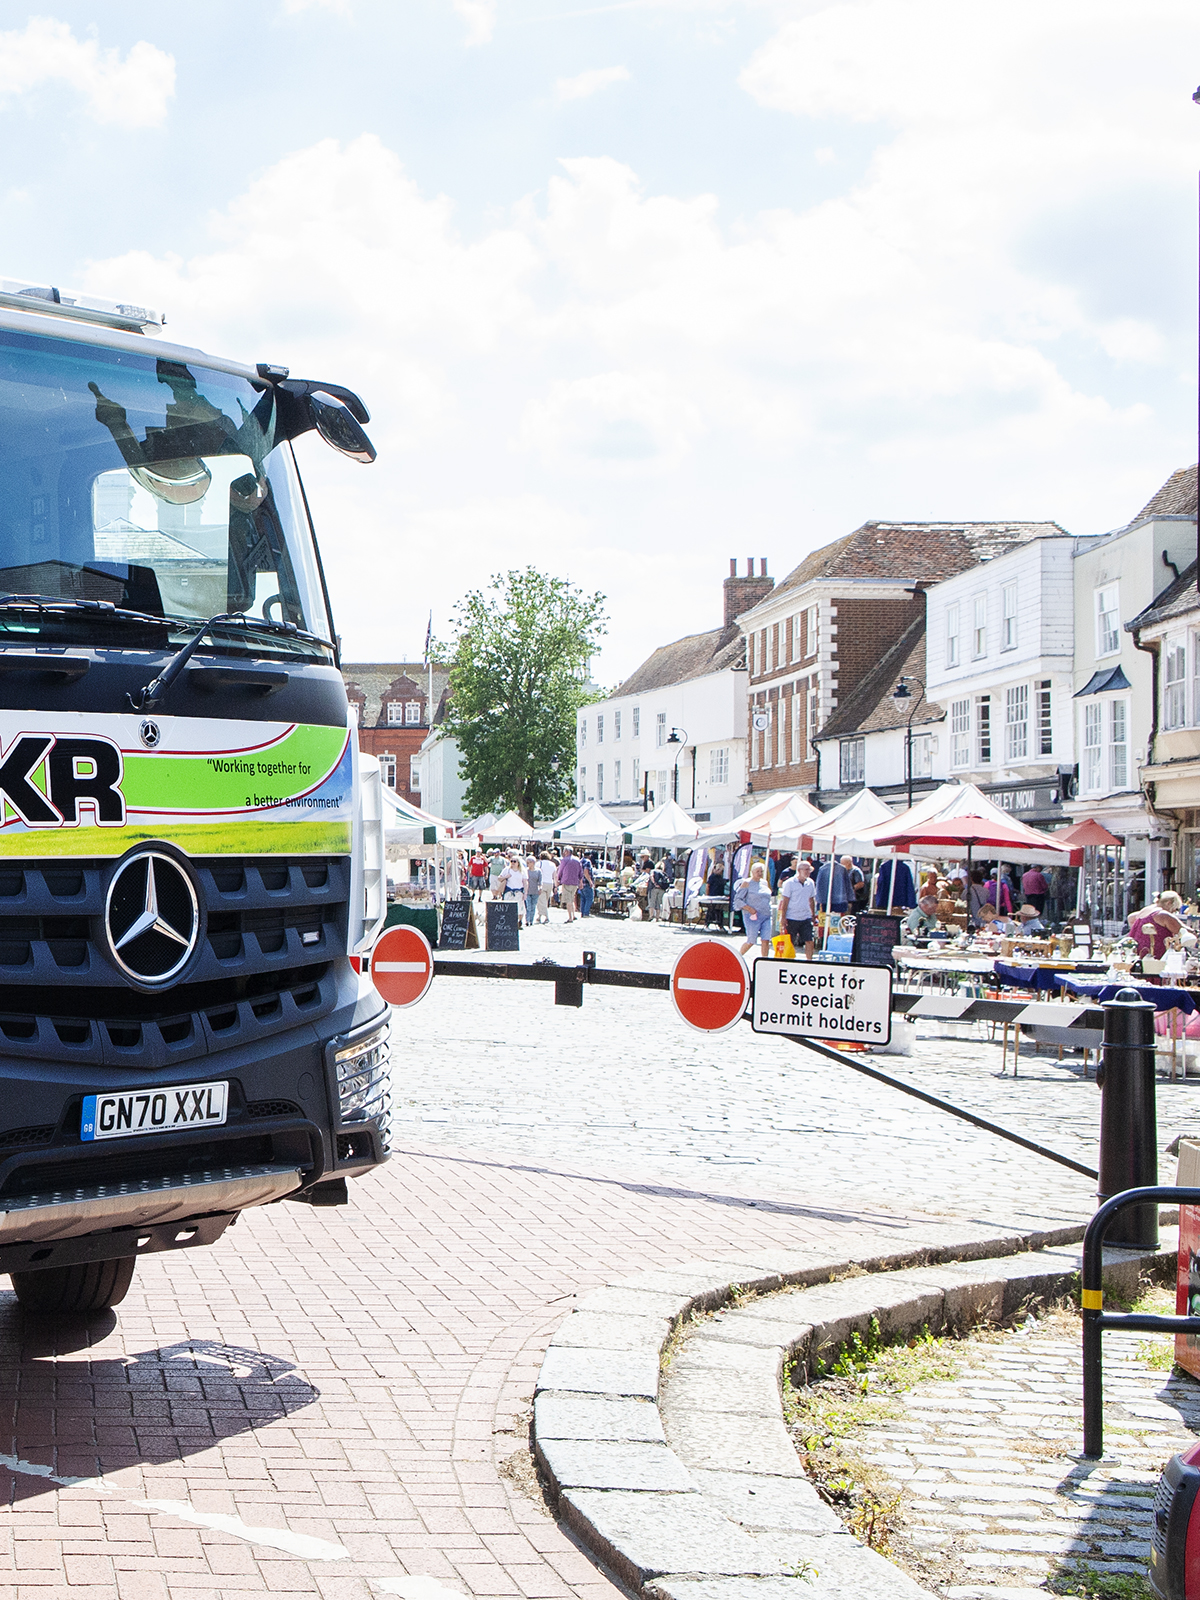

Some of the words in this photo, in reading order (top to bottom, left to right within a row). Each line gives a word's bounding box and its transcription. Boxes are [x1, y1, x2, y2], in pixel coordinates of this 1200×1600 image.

[257, 761, 296, 777] together
[298, 761, 311, 775] for
[245, 796, 251, 807] a
[253, 793, 283, 807] better
[1015, 790, 1035, 809] MOW
[494, 904, 509, 912] ANY
[778, 969, 834, 990] Except
[841, 973, 865, 990] for
[791, 993, 849, 1010] special
[760, 1011, 813, 1027] permit
[819, 1013, 882, 1034] holders
[99, 1093, 167, 1132] GN70
[173, 1088, 220, 1123] XXL
[83, 1123, 94, 1133] GB
